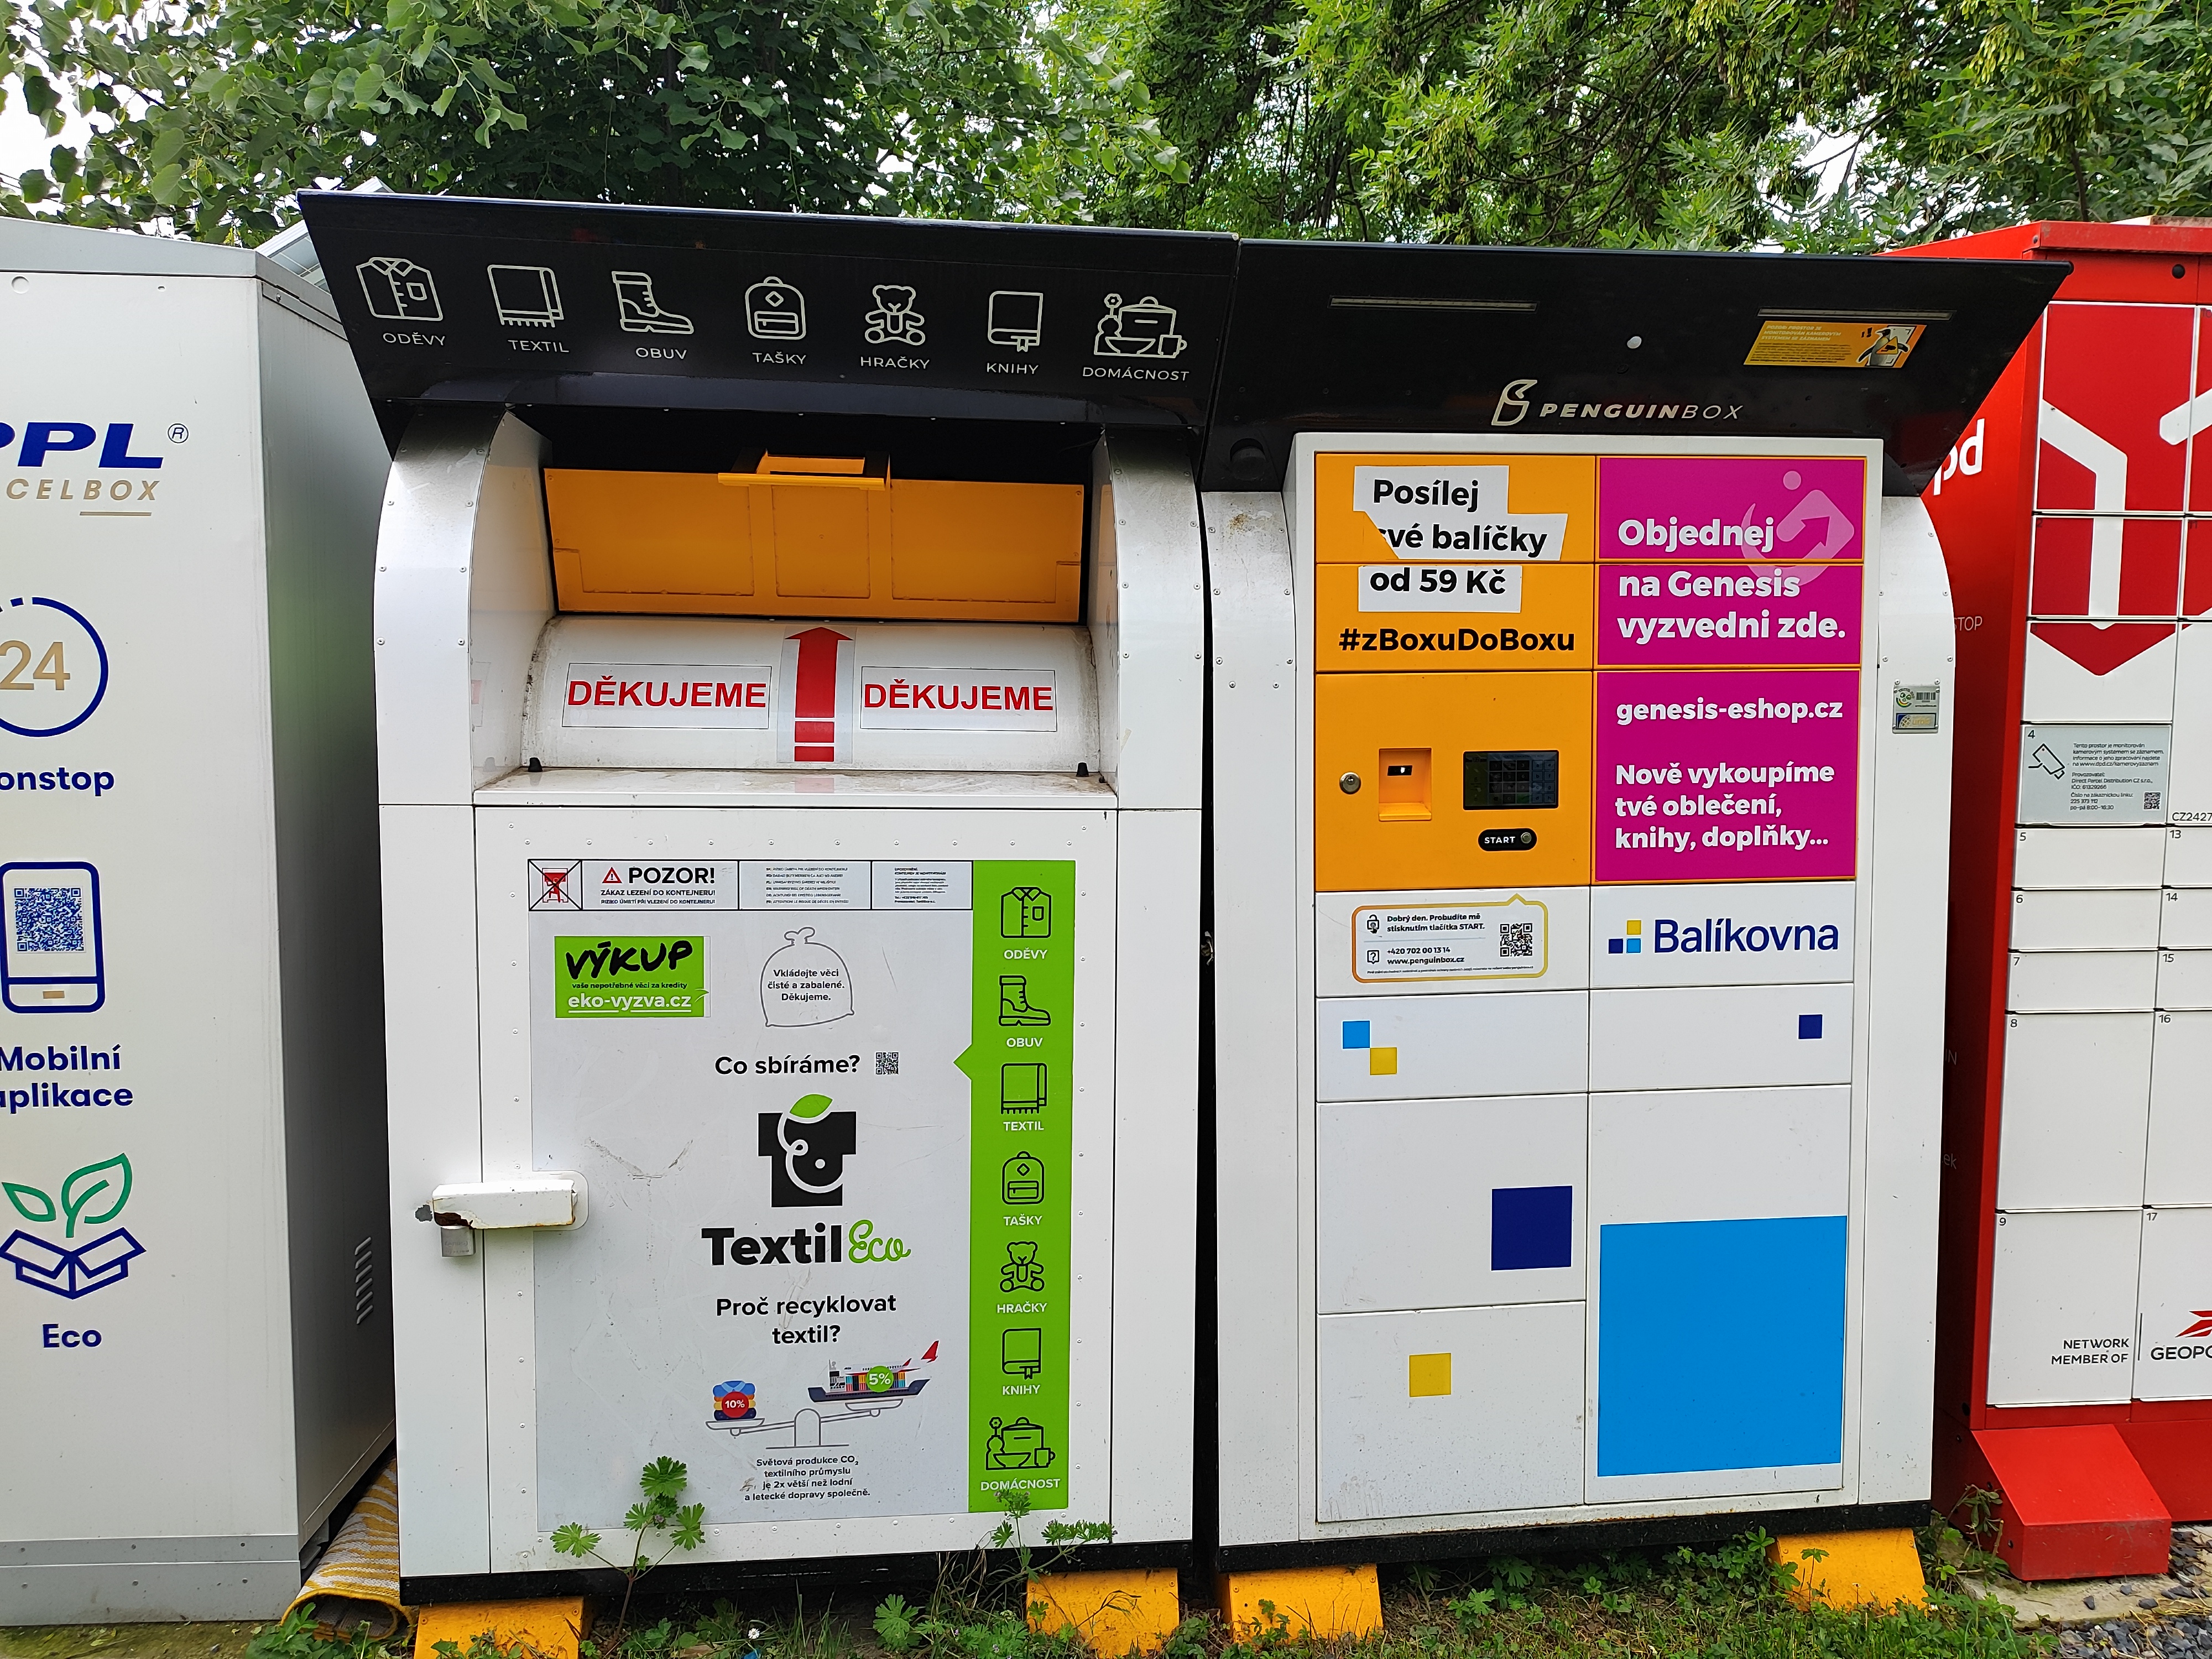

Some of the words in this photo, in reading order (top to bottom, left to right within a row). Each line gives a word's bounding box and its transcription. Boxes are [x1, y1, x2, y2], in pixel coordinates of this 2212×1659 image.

[383, 332, 445, 345] ODĚVY
[508, 340, 568, 352] TEXTIL
[636, 348, 686, 359] OBUV
[753, 352, 806, 364] TAŠKY
[861, 357, 929, 369] HRAČKY
[987, 363, 1038, 374] KNIHY
[1083, 367, 1189, 380] DOMÁCNOST
[1540, 404, 1743, 419] PENGUINBOX
[0, 422, 164, 468] PL
[1374, 479, 1478, 512] Posílej
[1433, 524, 1547, 557] balíčky
[1619, 515, 1773, 553] Objednej
[1370, 567, 1410, 591] od
[1420, 570, 1457, 592] 59
[1467, 569, 1505, 594] Kč
[1620, 576, 1660, 596] na
[1668, 567, 1800, 597] Genesis
[1617, 609, 1769, 644] vyzvedni
[1778, 612, 1845, 638] zde.
[1339, 628, 1574, 650] #zBoxuDoBoxu
[0, 640, 70, 691] 24
[568, 676, 765, 707] DĚKUJEME
[865, 679, 1053, 711] DĚKUJEME
[1617, 697, 1842, 725] genesis-eshop.cz
[2028, 730, 2035, 738] 4
[1616, 763, 1682, 784] Nově
[1688, 761, 1834, 788] vykoupíme
[1615, 795, 1657, 816] tvé
[1663, 793, 1781, 817] oblečení,
[1616, 826, 1695, 852] knihy,
[2020, 832, 2026, 841] 5
[2170, 830, 2181, 838] 13
[629, 868, 714, 883] POZOR!
[2016, 895, 2023, 903] 6
[1655, 919, 1838, 953] Balíkovna
[1004, 947, 1047, 959] ODĚVY
[2163, 954, 2174, 962] 15
[566, 941, 692, 979] VÝKUP
[1387, 956, 1464, 965] www.penguinbox.cz
[2013, 957, 2020, 966] 7
[773, 969, 817, 978] Vkládejte
[568, 993, 692, 1011] eko-vyzva.cz
[782, 993, 831, 1002] Děkujeme.
[2011, 1019, 2017, 1027] 8
[2159, 1015, 2171, 1023] 16
[1007, 1038, 1042, 1047] OBUV
[0, 1044, 121, 1071] Mobilní
[716, 1057, 747, 1074] Co
[755, 1055, 860, 1074] sbíráme?
[1003, 1121, 1044, 1131] TEXTIL
[1003, 1214, 1042, 1225] TAŠKY
[717, 1297, 768, 1316] Proč
[778, 1295, 896, 1318] recyklovat
[998, 1301, 1047, 1313] HRAČKY
[43, 1324, 101, 1348] Eco
[772, 1325, 840, 1344] textil?
[2064, 1338, 2129, 1349] NETWORK
[2052, 1354, 2107, 1364] MEMBER
[2111, 1354, 2128, 1363] OF
[869, 1373, 892, 1386] 5%
[1003, 1385, 1040, 1395] KNIHY
[757, 1458, 792, 1466] Světová
[796, 1457, 838, 1466] produkce
[764, 1469, 806, 1477] textilního
[810, 1467, 850, 1477] průmyslu
[763, 1481, 771, 1490] je
[980, 1477, 1061, 1491] DOMÁCNOST
[753, 1492, 785, 1500] letecké
[828, 1488, 870, 1498] společně.
